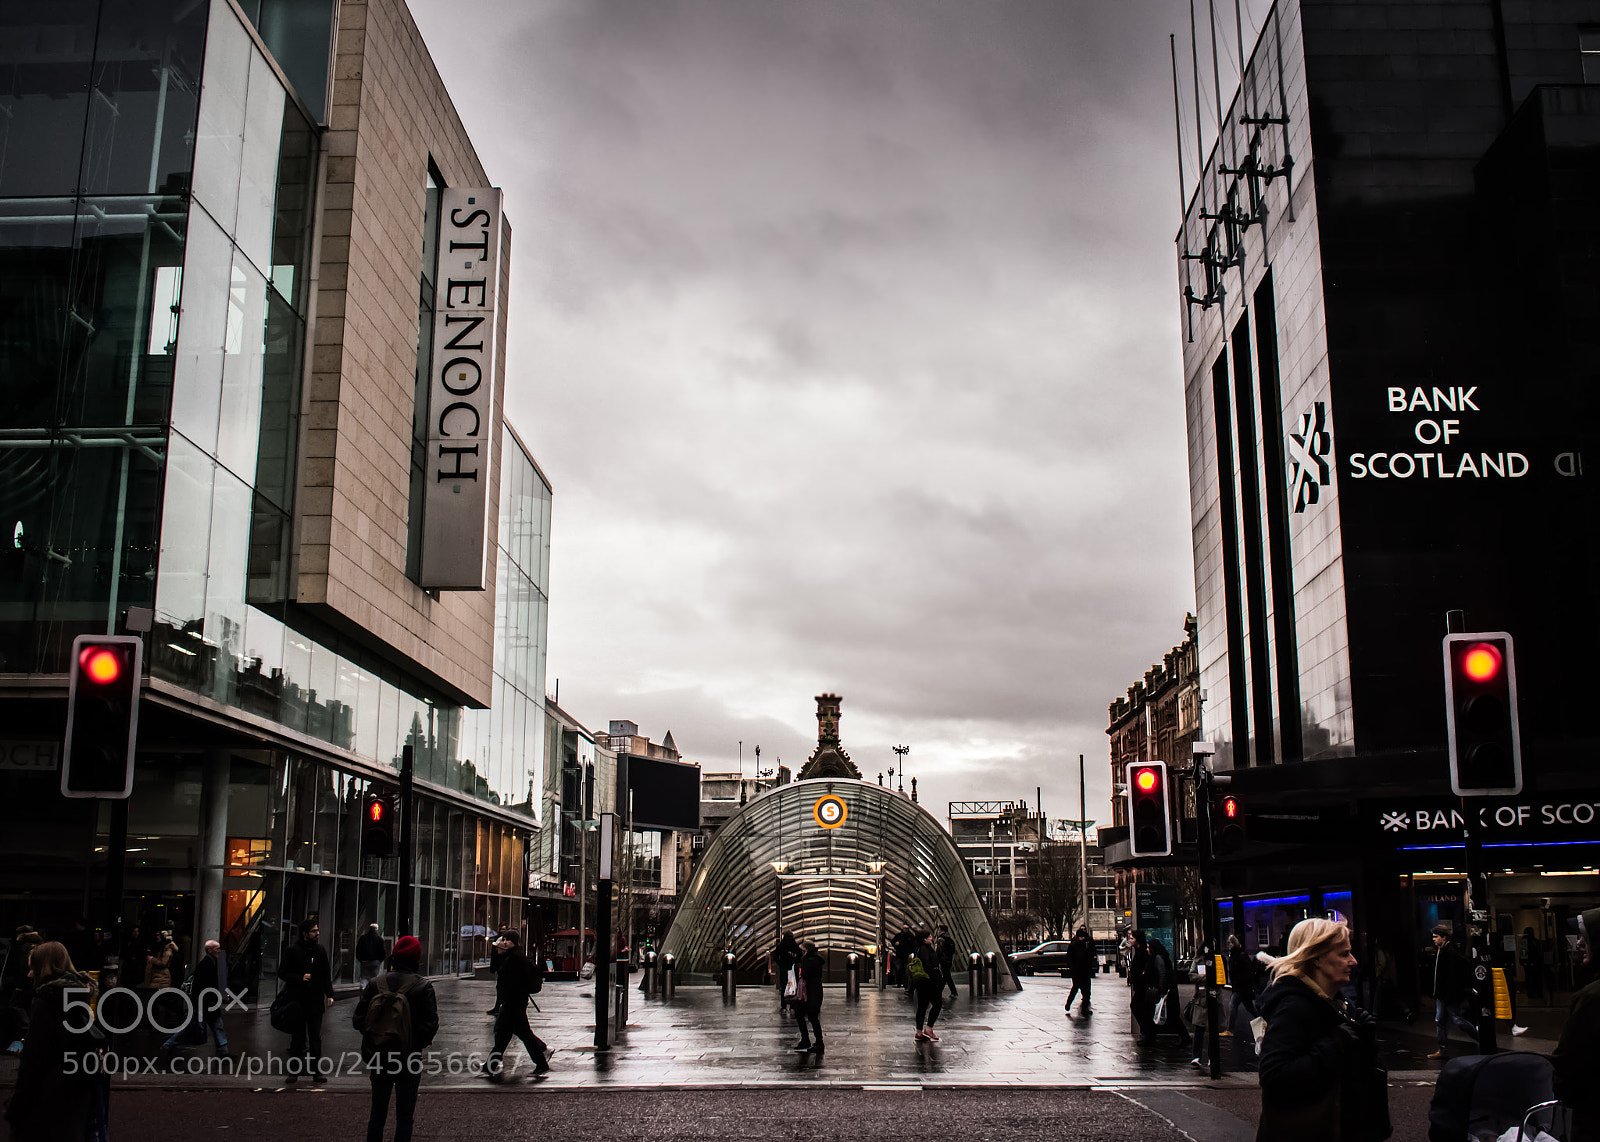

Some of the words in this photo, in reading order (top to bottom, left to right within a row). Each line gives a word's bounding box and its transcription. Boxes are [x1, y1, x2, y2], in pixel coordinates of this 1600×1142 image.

[449, 208, 491, 262] ST
[437, 277, 487, 483] ENOCH
[1387, 386, 1480, 412] BANK
[1414, 419, 1460, 445] OF
[1349, 452, 1530, 479] SCOTLAND
[827, 806, 835, 817] S
[1495, 805, 1531, 827] OF
